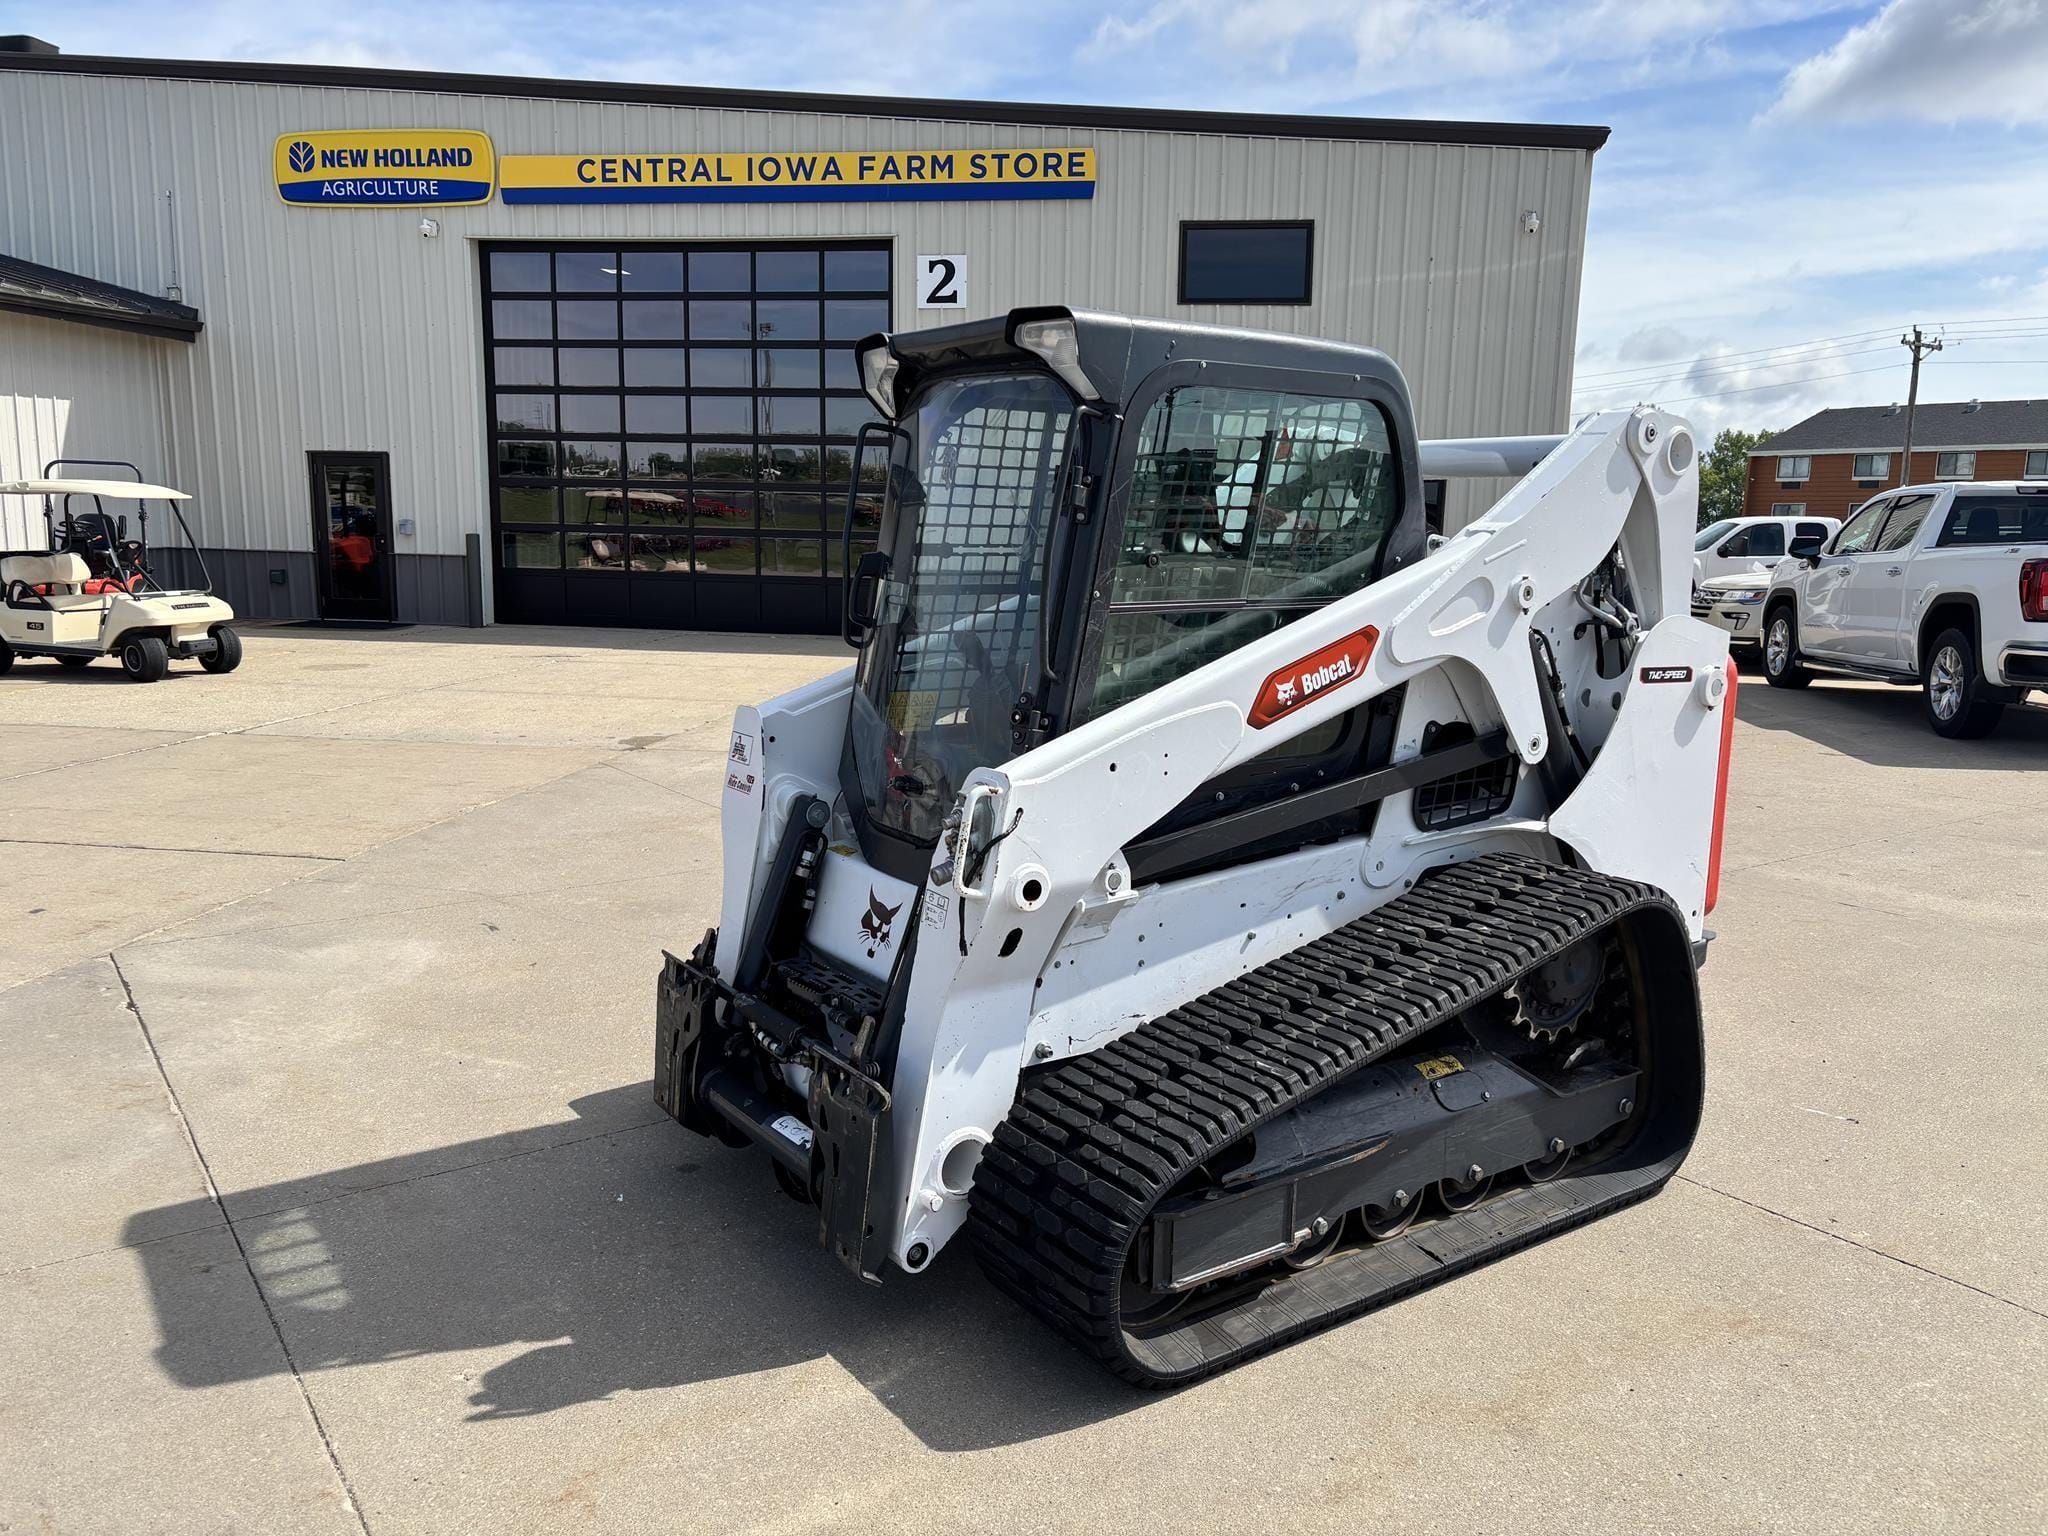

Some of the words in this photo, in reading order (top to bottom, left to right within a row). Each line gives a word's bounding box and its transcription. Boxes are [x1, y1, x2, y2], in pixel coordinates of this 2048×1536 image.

[321, 149, 368, 168] NEW
[373, 148, 473, 168] HOLLAND
[577, 157, 733, 184] CENTRAL
[747, 156, 844, 183] IOWA
[858, 154, 954, 181] FARM
[969, 152, 1086, 179] STORE
[322, 180, 439, 196] AGRICULTURE
[926, 259, 958, 304] 2
[1301, 653, 1352, 695] Bobcat
[1648, 670, 1687, 680] TWO-SPEED
